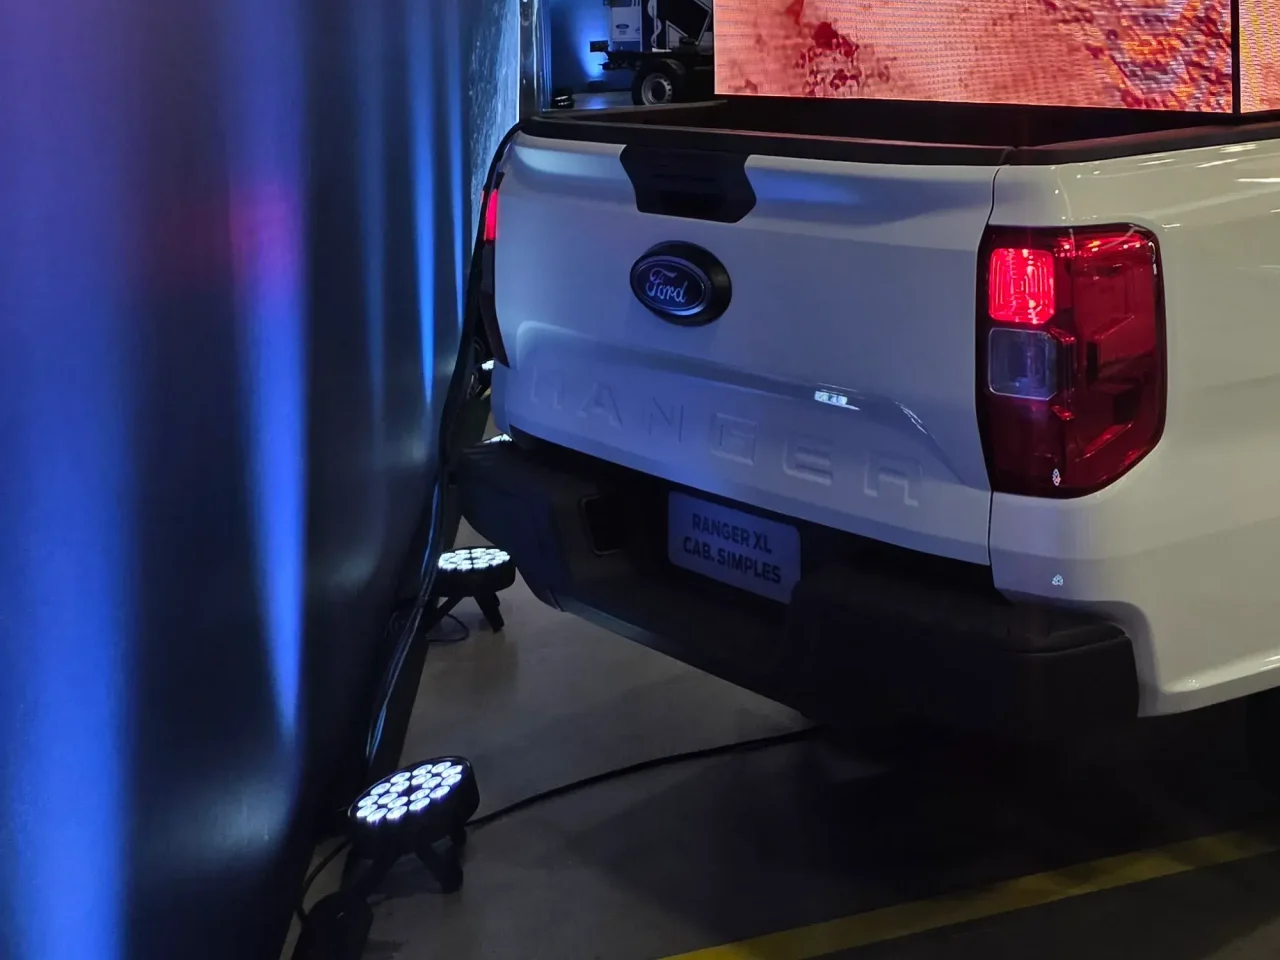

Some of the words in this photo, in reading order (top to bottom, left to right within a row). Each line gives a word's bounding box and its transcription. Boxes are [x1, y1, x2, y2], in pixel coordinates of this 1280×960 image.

[646, 267, 688, 303] Ford
[530, 365, 922, 507] RANGER
[692, 513, 751, 548] RANGER
[752, 530, 773, 555] XL
[683, 536, 716, 563] CAB.
[717, 547, 782, 584] SIMPLES
